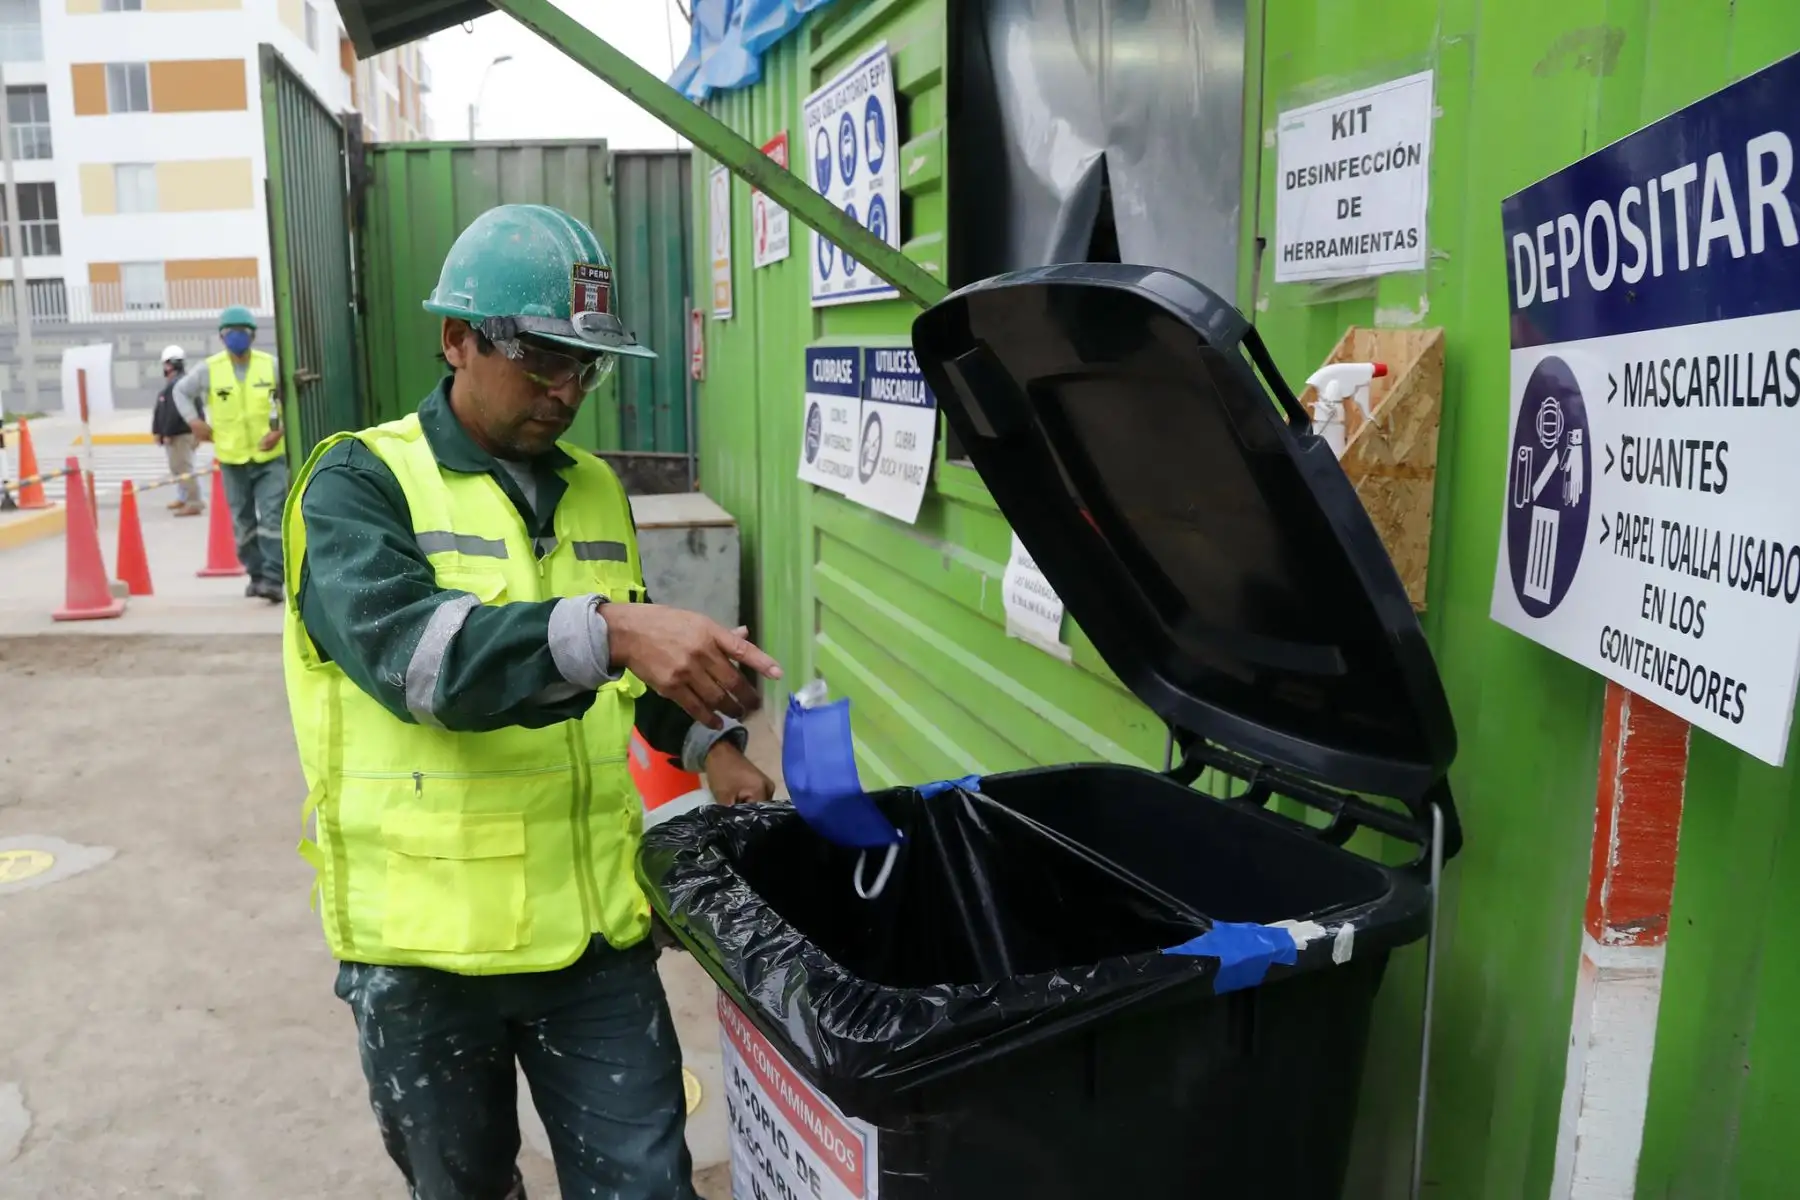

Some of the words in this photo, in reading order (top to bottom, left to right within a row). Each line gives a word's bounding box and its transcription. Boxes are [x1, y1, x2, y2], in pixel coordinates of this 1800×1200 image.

[1332, 104, 1372, 141] KIT
[1286, 141, 1422, 190] DESINFECCIÓN
[1337, 196, 1362, 220] DE
[1512, 131, 1800, 309] DEPOSITAR
[1284, 228, 1418, 262] HERRAMIENTAS
[812, 359, 853, 384] CUBRASE
[875, 350, 907, 373] UTILICE
[1624, 348, 1800, 408] MASCARILLAS
[870, 377, 926, 405] MASCARILLA
[1621, 435, 1729, 494] GUANTES
[1615, 512, 1654, 564] PAPEL
[1660, 520, 1720, 583] TOALLA
[1728, 533, 1800, 604] USADO
[1641, 583, 1666, 624] EN
[1669, 592, 1706, 639] LOS
[1600, 626, 1747, 724] CONTENEDORES
[734, 1066, 789, 1160] ACOPIO
[795, 1150, 822, 1200] DE
[753, 1044, 855, 1173] CONTAMINADOS
[727, 1094, 797, 1200] MASCARI
